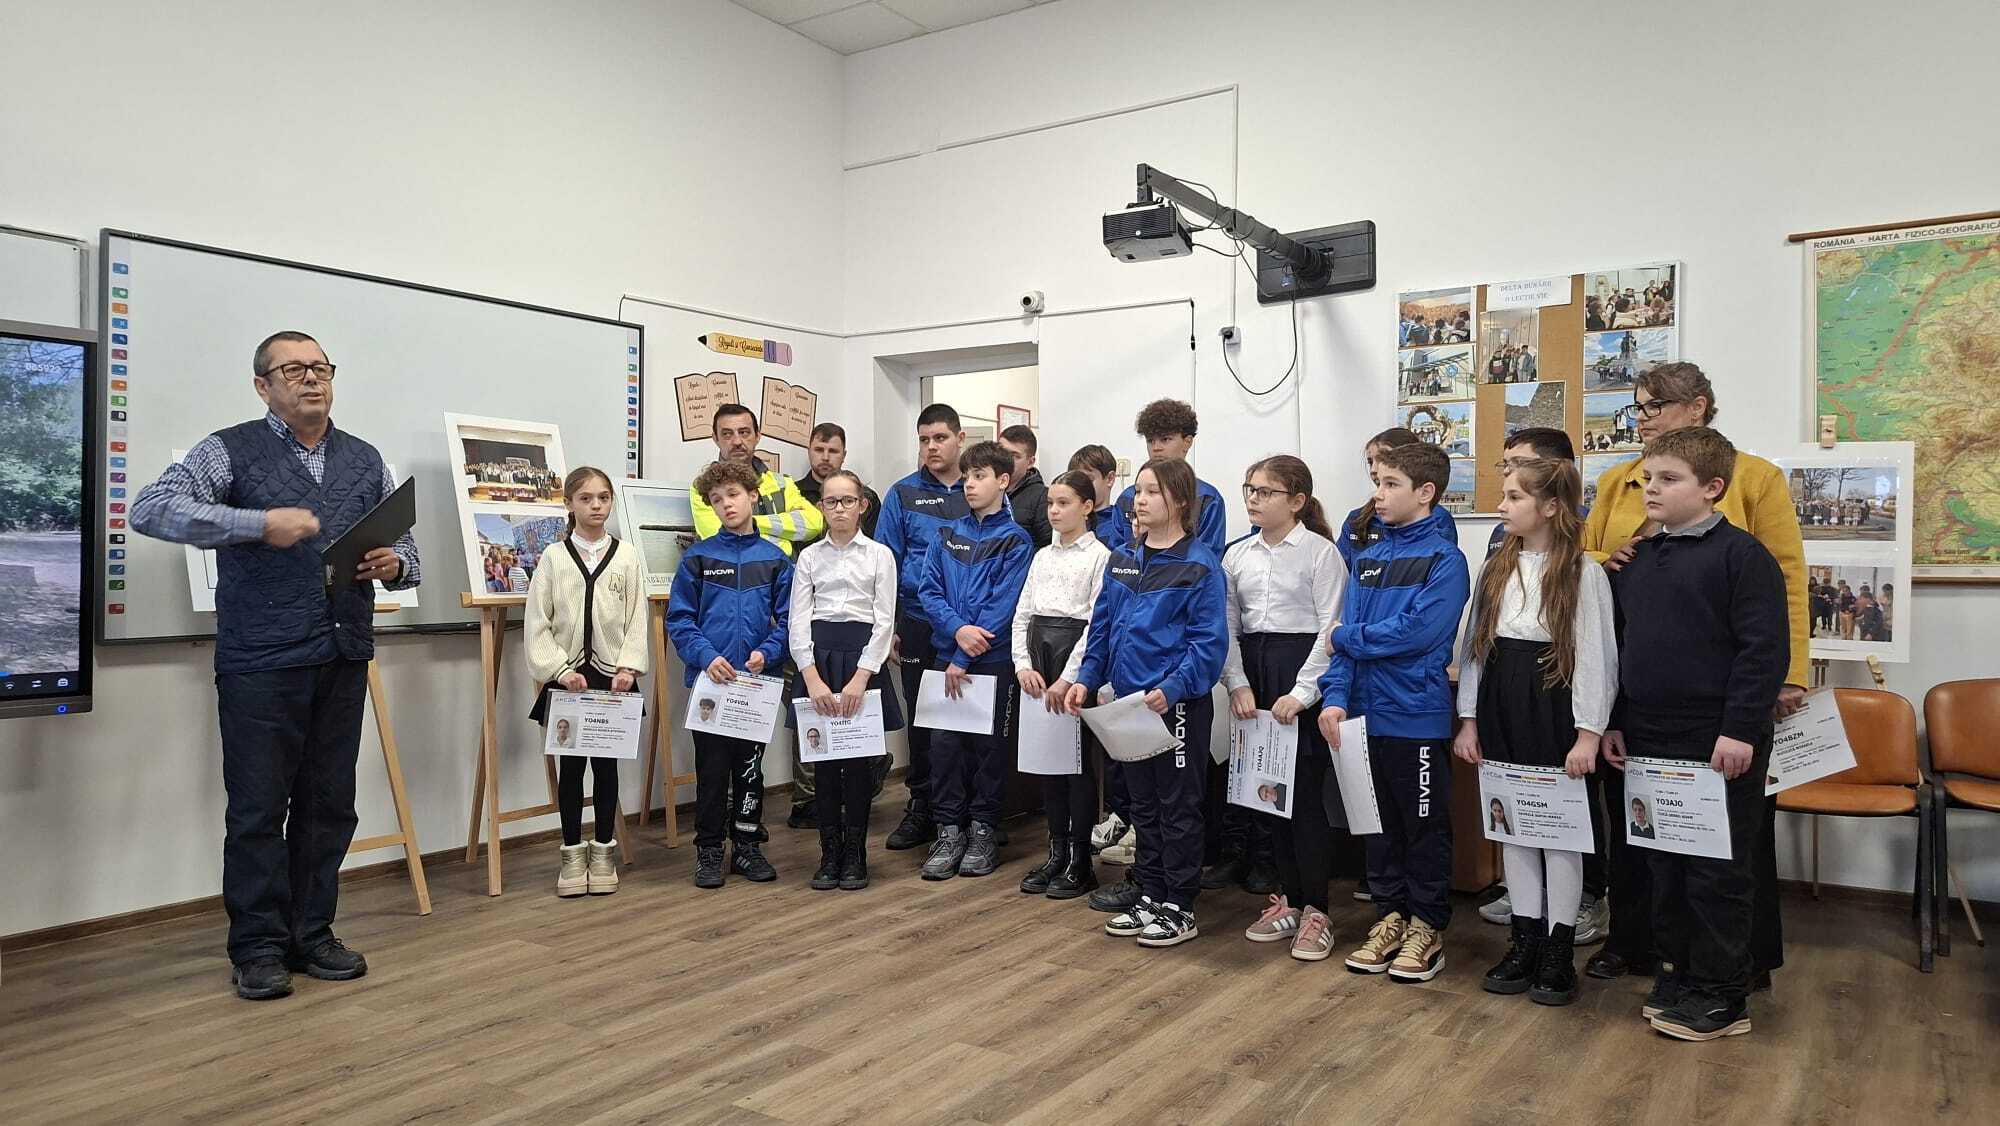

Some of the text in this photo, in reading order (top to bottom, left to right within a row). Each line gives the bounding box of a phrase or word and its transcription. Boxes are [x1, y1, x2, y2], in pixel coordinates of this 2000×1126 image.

[1813, 237, 1856, 249] ROMÂNIA
[1868, 233, 1900, 243] HARTA
[703, 568, 735, 576] GIVOVA
[1111, 567, 1140, 575] GIVOVA
[1003, 683, 1014, 737] GIVOVA
[1175, 702, 1186, 768] GIVOVA
[1418, 746, 1431, 817] GIVOVA
